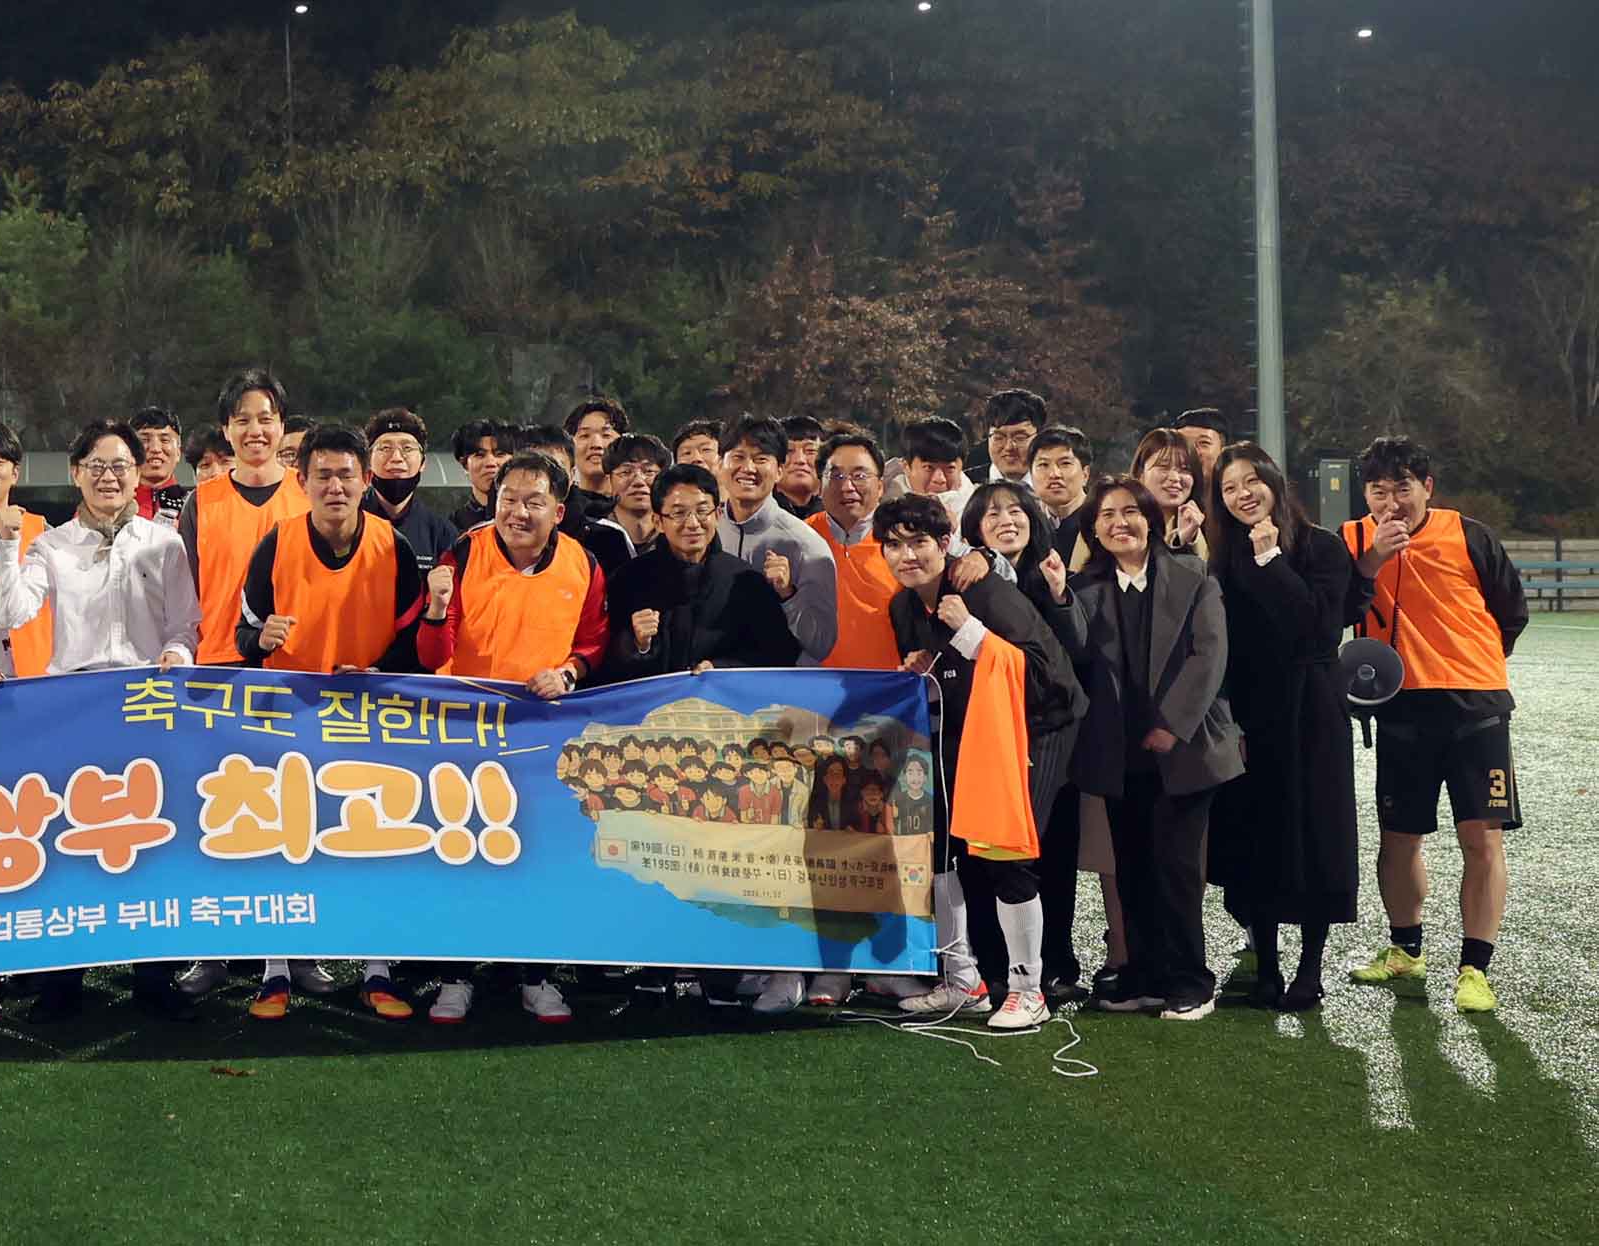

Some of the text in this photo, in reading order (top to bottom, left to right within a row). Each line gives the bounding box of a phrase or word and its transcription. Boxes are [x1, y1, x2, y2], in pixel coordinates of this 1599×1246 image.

[122, 677, 508, 748] 축구도 잘한다!
[197, 751, 521, 866] 최고!!
[1489, 769, 1507, 798] 3
[117, 899, 180, 930] 부내
[190, 893, 316, 927] 축구대회
